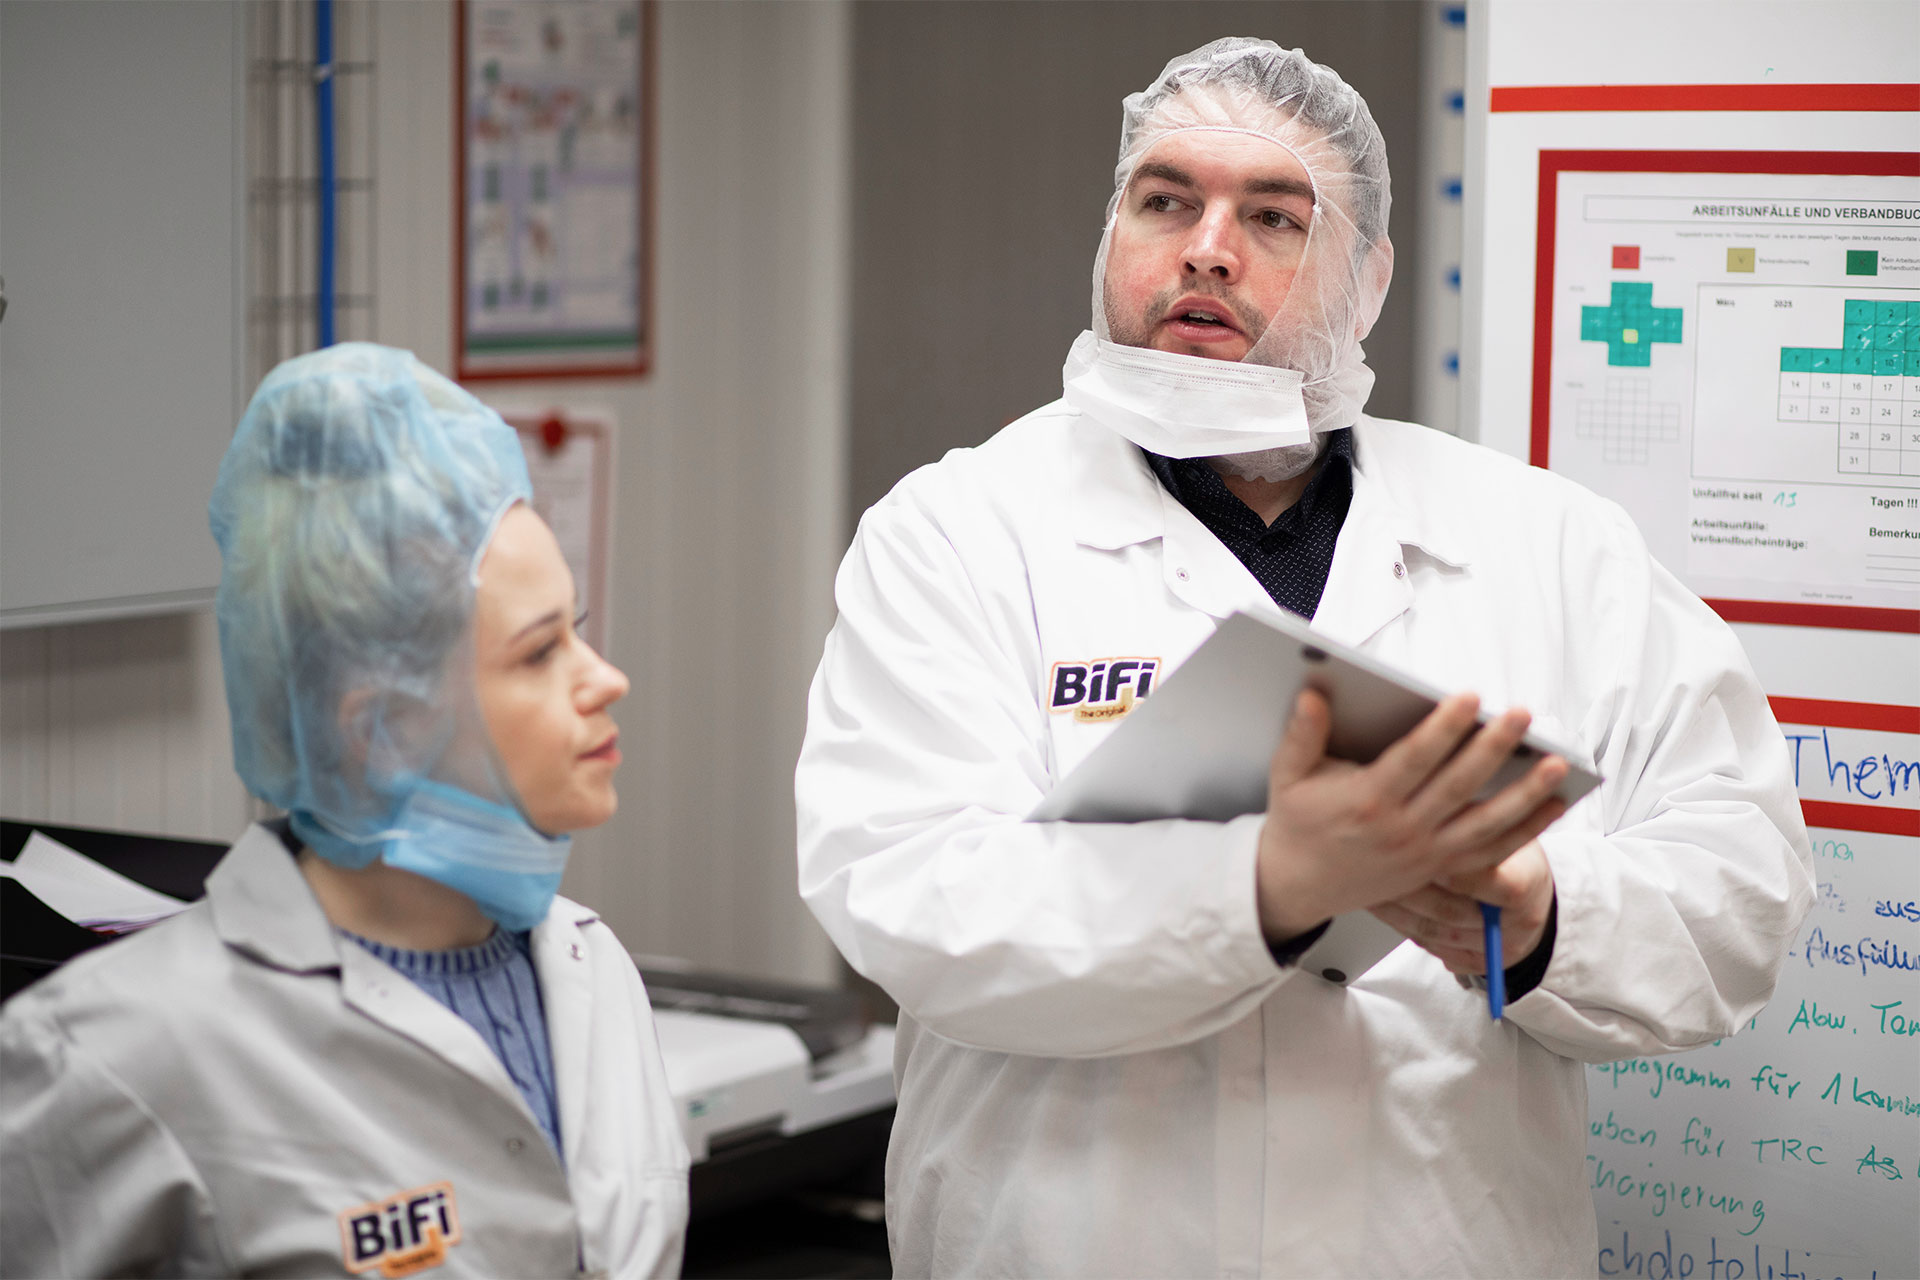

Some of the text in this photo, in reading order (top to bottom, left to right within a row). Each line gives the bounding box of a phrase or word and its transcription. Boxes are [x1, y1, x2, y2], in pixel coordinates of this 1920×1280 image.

[1692, 204, 1800, 217] ARBEITSUNFÄLLE
[1804, 207, 1831, 218] UND
[1852, 382, 1862, 391] 16
[1883, 383, 1893, 392] 17
[1850, 407, 1861, 416] 23
[1881, 408, 1892, 416] 24
[1849, 431, 1860, 441] 28
[1880, 433, 1891, 441] 29
[1849, 456, 1859, 465] 31
[1692, 488, 1763, 501] Unfallfrei seit
[1870, 496, 1904, 509] Tagen
[1868, 526, 1920, 540] Bemerku
[1052, 661, 1155, 706] BiFi
[1751, 1065, 1801, 1099] für
[1681, 1117, 1725, 1158] für
[1751, 1137, 1829, 1165] TRC
[351, 1191, 449, 1261] BiFi
